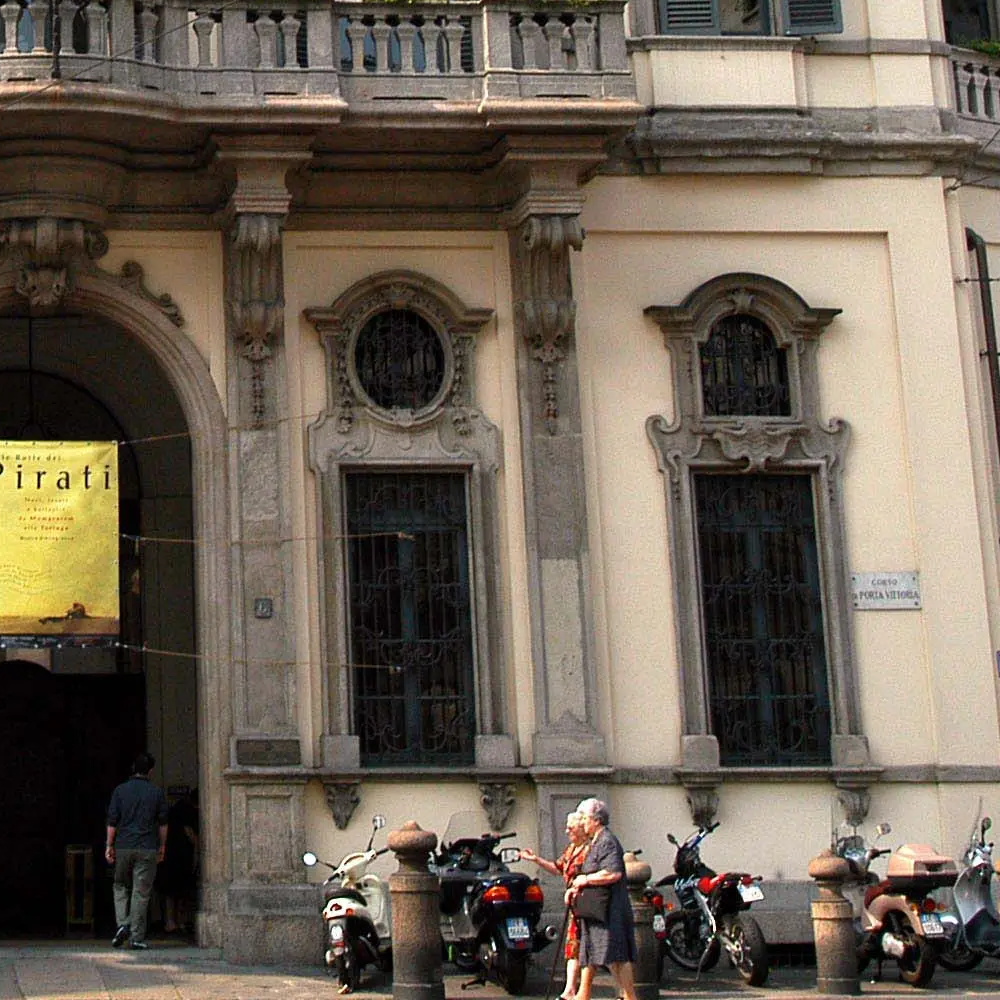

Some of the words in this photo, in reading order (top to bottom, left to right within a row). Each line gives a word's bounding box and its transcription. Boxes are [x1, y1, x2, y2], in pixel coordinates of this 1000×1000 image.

[871, 578, 898, 586] CORSO
[859, 590, 884, 600] PORTA
[885, 590, 920, 600] VITTORIA
